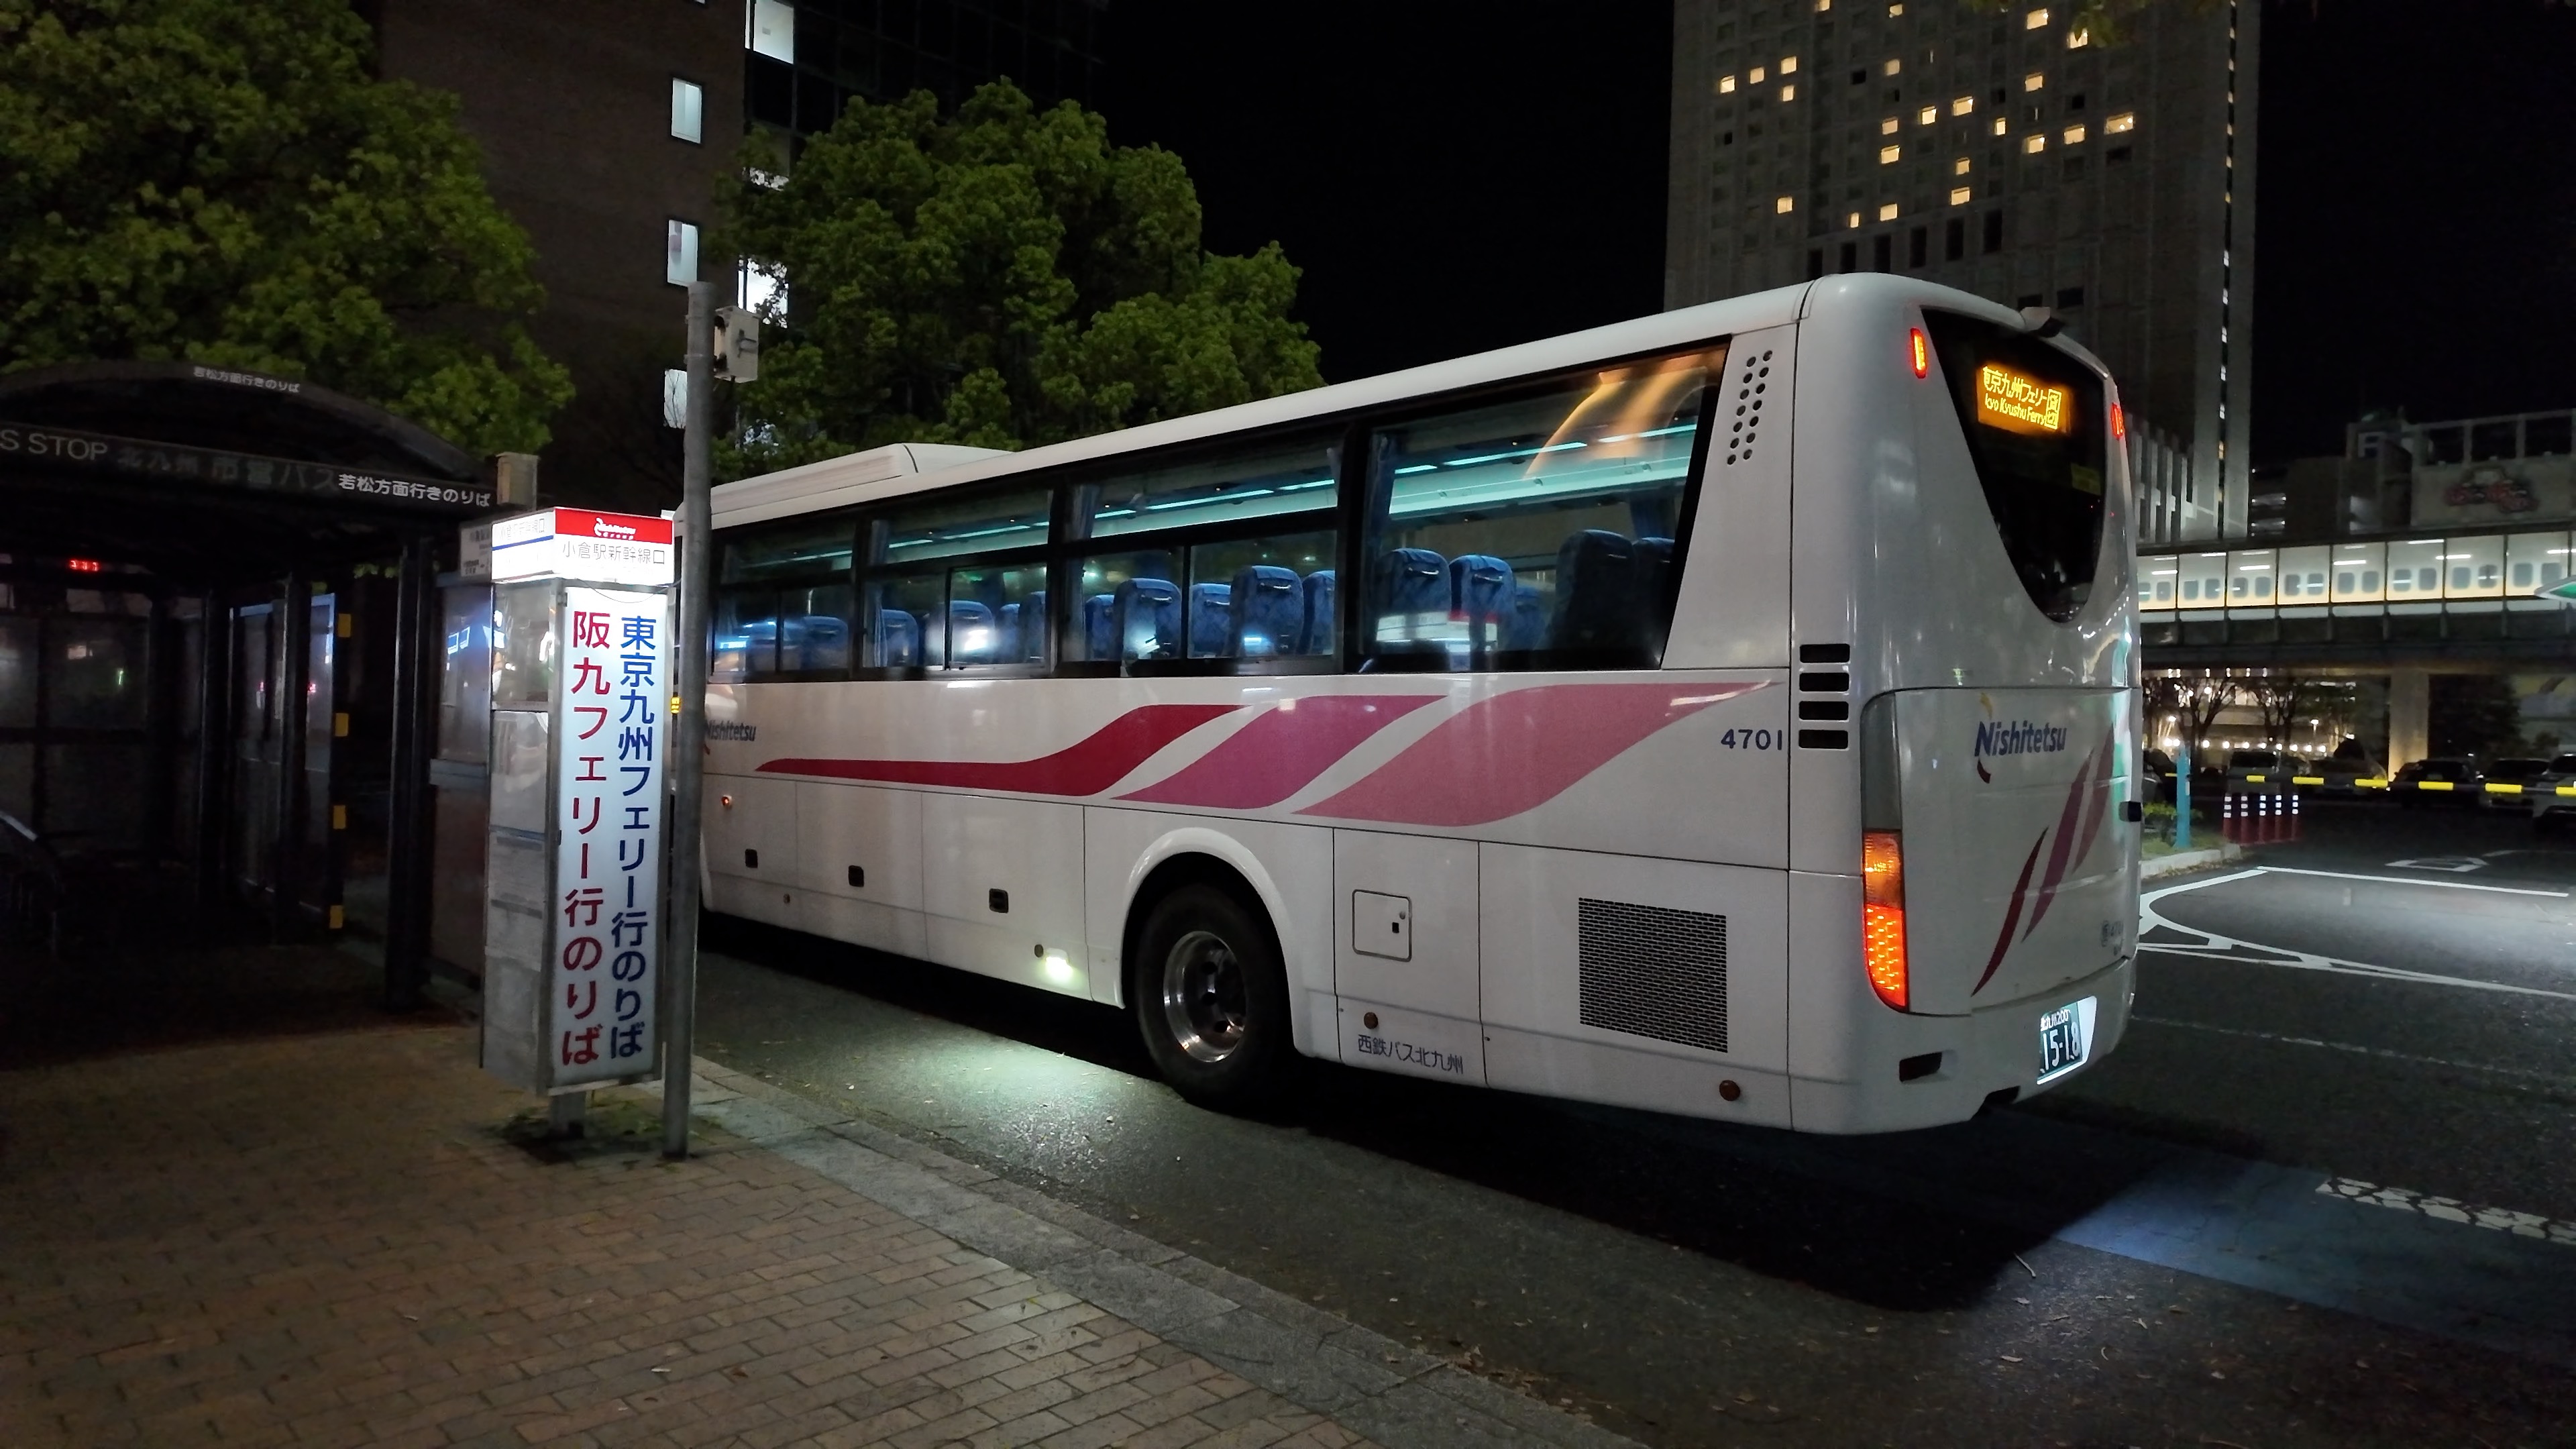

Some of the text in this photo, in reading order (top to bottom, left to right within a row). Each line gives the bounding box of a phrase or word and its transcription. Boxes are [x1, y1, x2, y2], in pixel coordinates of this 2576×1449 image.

[193, 366, 301, 393] 若松方面行きのりば
[28, 433, 108, 461] STOP
[338, 474, 491, 507] 若松方面行きのりば
[562, 541, 665, 565] 小倉駅新幹線口
[1721, 729, 1782, 750] 4701
[1974, 720, 2068, 757] Nishitetsu
[561, 611, 611, 1065] 阪九フェリー行のりば
[611, 615, 657, 1060] 東京九州フェリー行のりば
[1358, 1034, 1464, 1074] 西鉄バス北九州
[2043, 1022, 2080, 1067] 15-18
